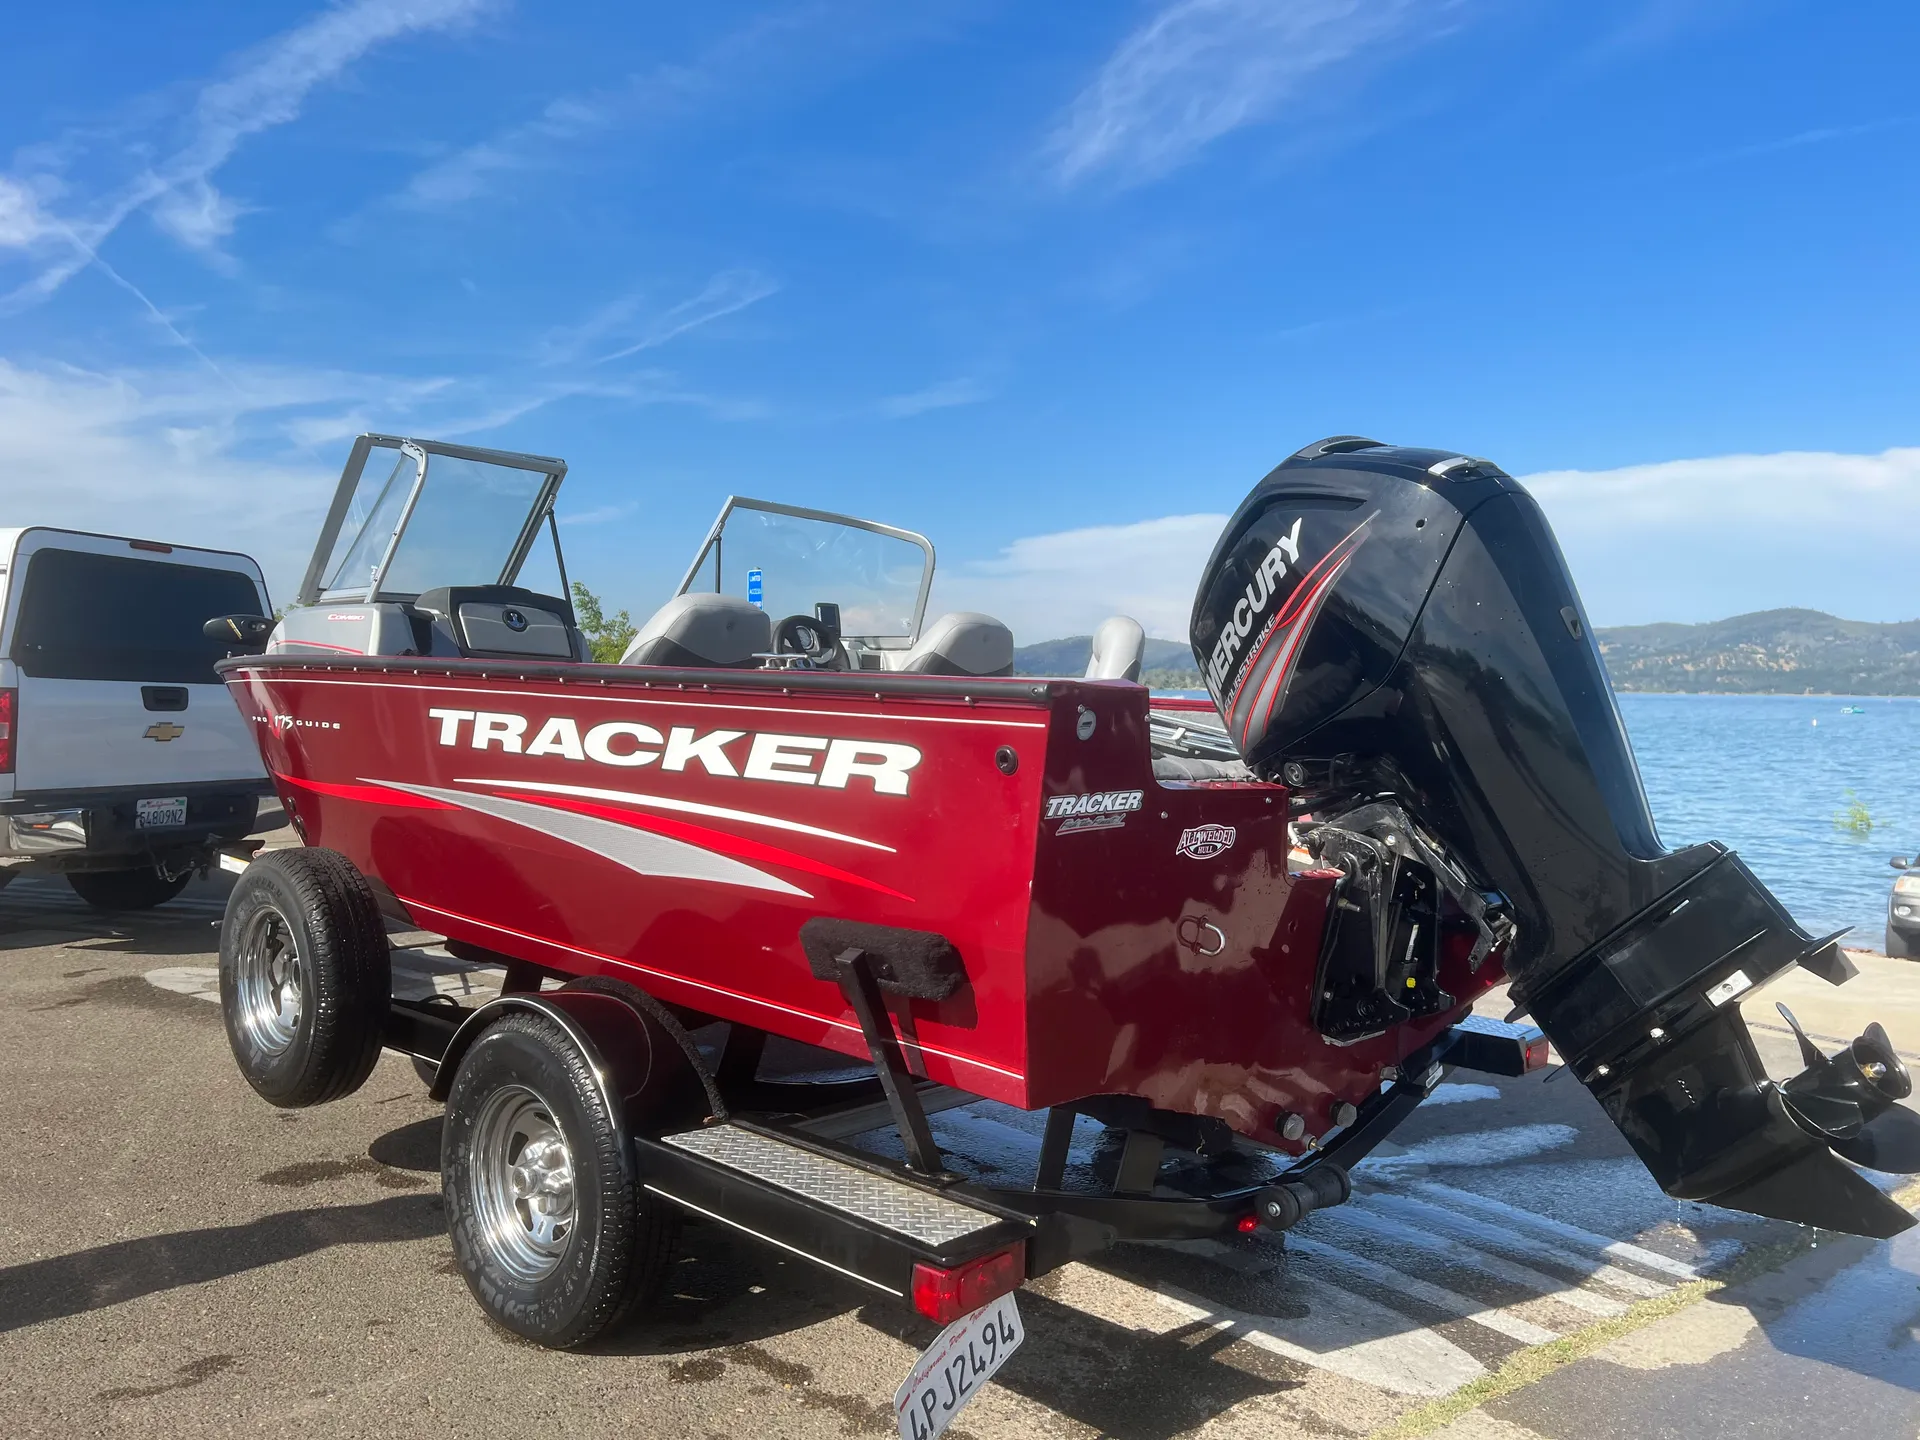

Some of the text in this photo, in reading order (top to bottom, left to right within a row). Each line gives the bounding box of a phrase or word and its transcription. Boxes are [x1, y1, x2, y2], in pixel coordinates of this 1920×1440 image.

[1205, 517, 1302, 708] MERCURY
[251, 714, 341, 730] PRO 175 GUIDE
[428, 707, 923, 797] TRACKER
[1045, 791, 1143, 818] TRACKER
[910, 1310, 1015, 1440] 4PJ2494
